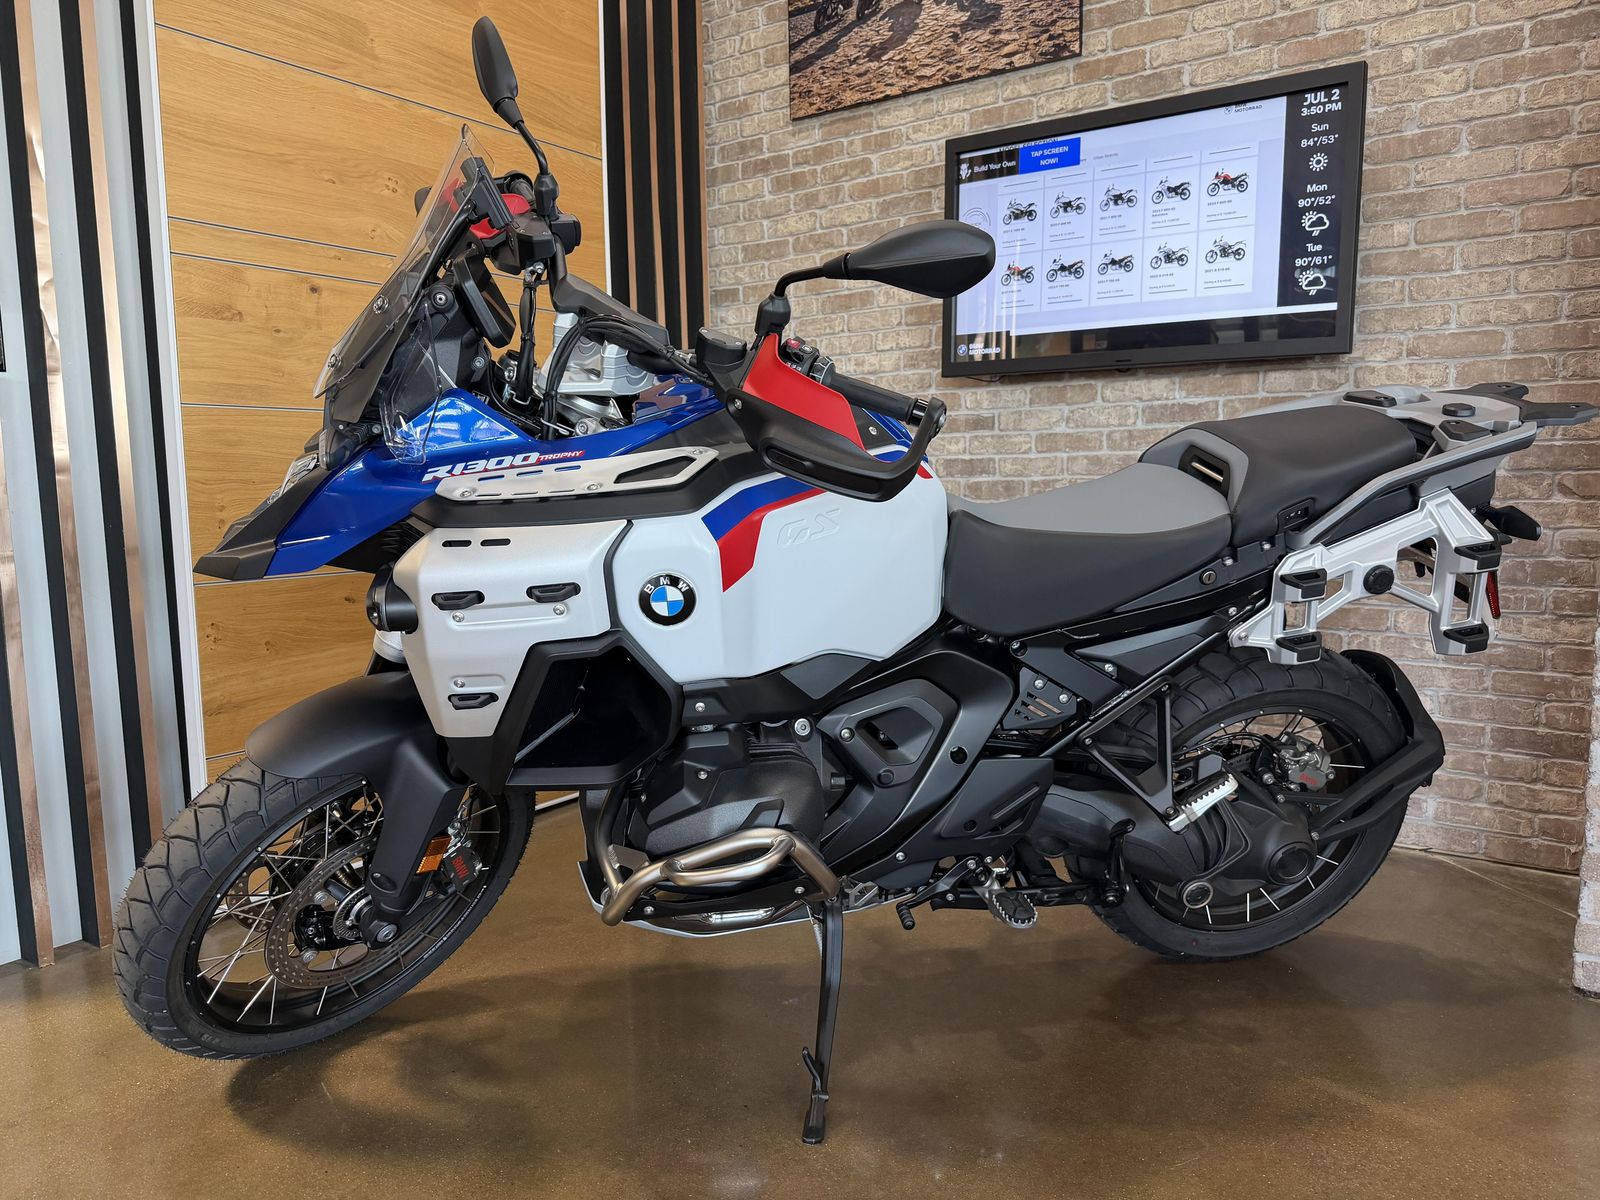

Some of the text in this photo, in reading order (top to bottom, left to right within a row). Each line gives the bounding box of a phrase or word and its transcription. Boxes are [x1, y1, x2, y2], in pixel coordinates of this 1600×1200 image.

[1303, 88, 1340, 106] JUL 2
[1300, 101, 1342, 117] 3:50 PM
[1311, 123, 1329, 132] Sun
[1030, 150, 1043, 158] TAP
[1043, 145, 1069, 156] SCREEN
[973, 160, 1017, 173] Build Your Own
[1039, 157, 1059, 166] NOW!
[1306, 183, 1328, 193] Mon
[1305, 243, 1323, 252] Tue
[539, 450, 584, 462] TROPHY
[643, 576, 690, 595] BMW
[451, 855, 470, 880] BMW
